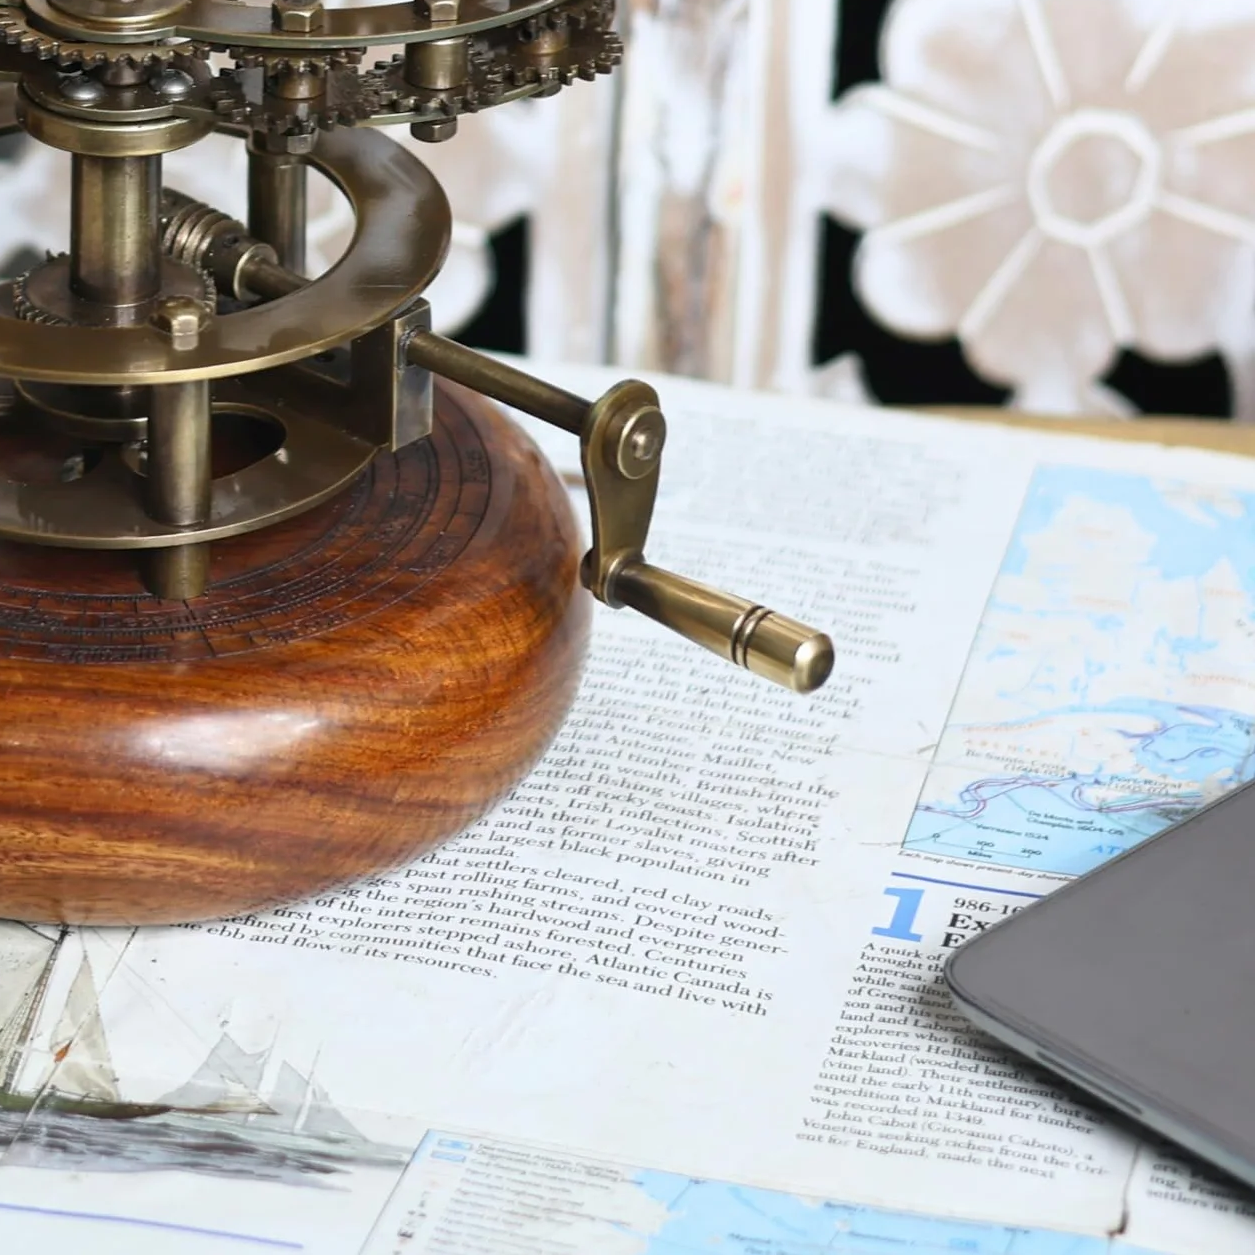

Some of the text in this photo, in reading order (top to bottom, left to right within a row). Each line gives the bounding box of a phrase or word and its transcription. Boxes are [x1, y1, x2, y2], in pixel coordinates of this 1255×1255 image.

[488, 830, 751, 887] largest black population in
[404, 868, 787, 938] past rolling farms, and covered wood-
[465, 858, 773, 922] settlers cleared, red clay roads
[366, 889, 399, 903] the
[488, 901, 591, 931] hardwood
[594, 925, 634, 939] and
[638, 934, 744, 962] evergreen
[407, 882, 789, 955] span rushing streams. Despite gener-
[871, 886, 925, 942] 1
[207, 925, 498, 979] ebb and flow of its resources.
[315, 896, 747, 979] of the interior remains forested. Centuries
[317, 914, 774, 1001] explorers stepped ashore, Atlantic Canada is
[863, 942, 945, 962] A quirk of
[329, 930, 768, 1017] communities that face the sea and live with
[855, 963, 927, 983] America.
[859, 951, 922, 971] brought
[844, 1001, 931, 1017] son and his
[847, 987, 867, 995] of
[852, 975, 951, 999] while sailing
[835, 1025, 946, 1042] explorers who
[840, 1010, 908, 1026] land and
[827, 1046, 980, 1075] Markland (wooded
[831, 1035, 921, 1052] discoveries
[813, 1083, 1094, 1135] expedition to Markland for timber
[819, 1071, 1047, 1111] until the early 11th century,
